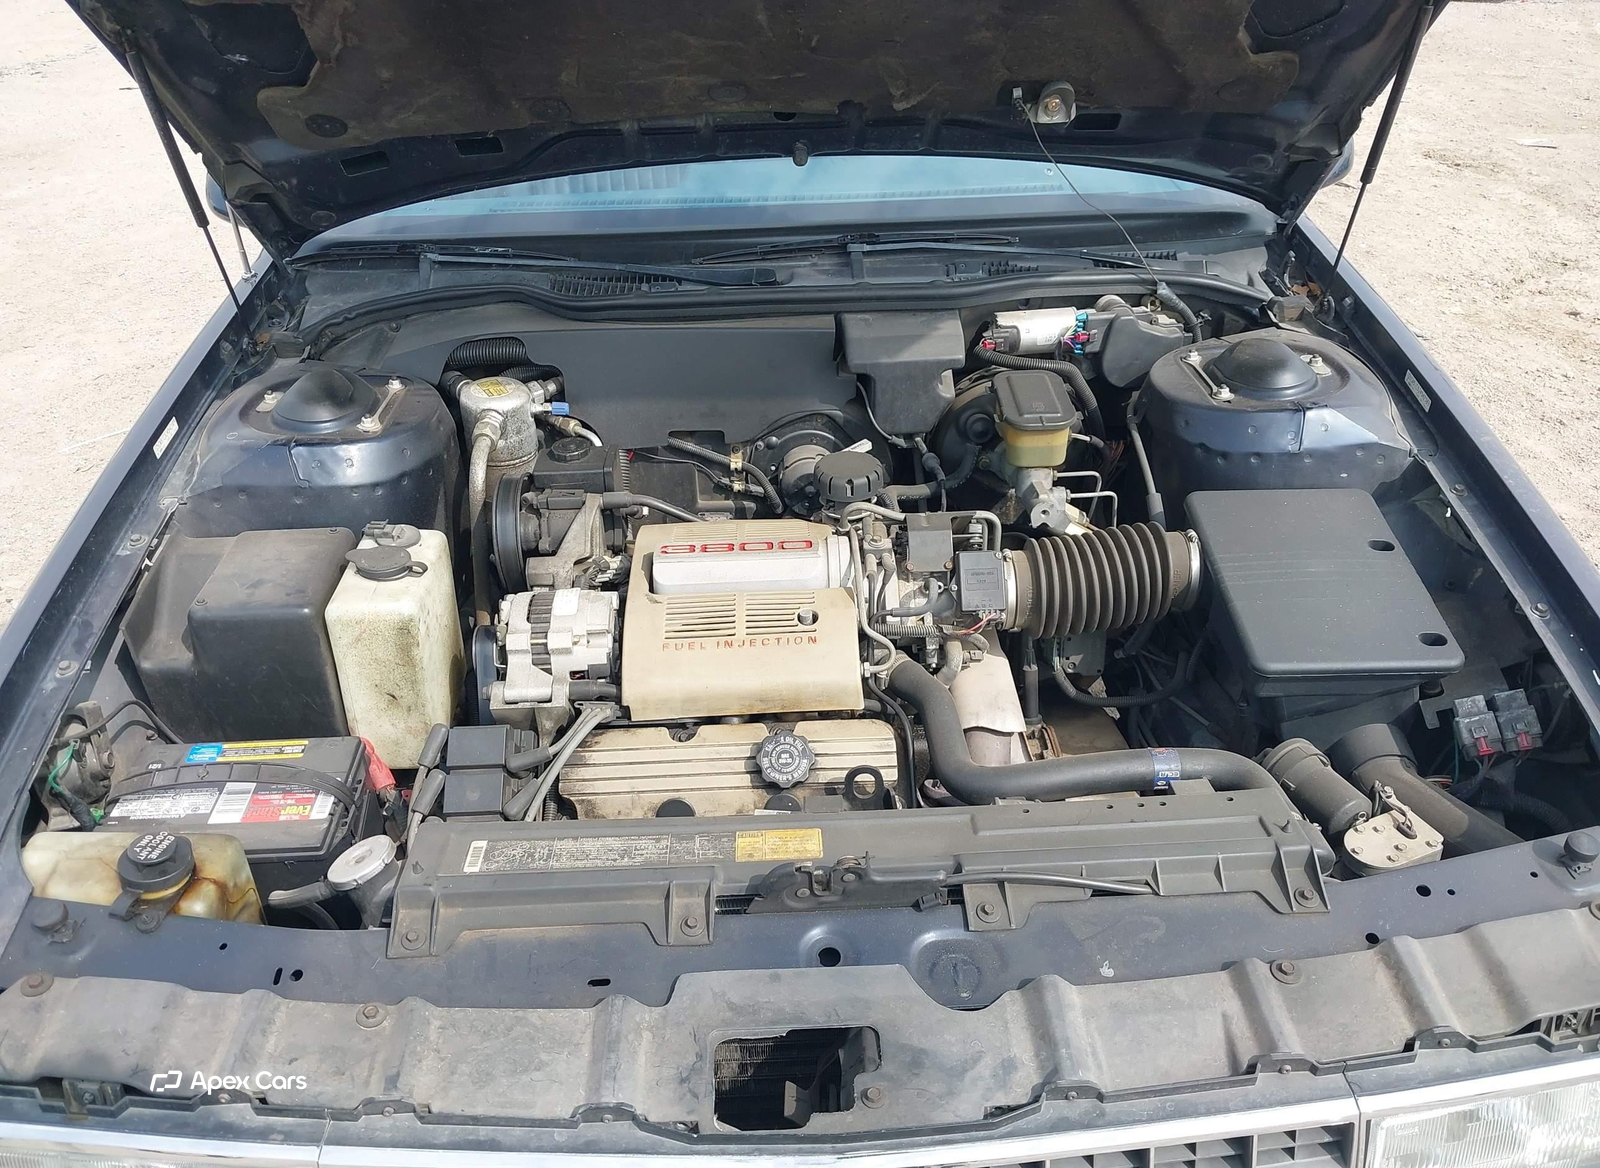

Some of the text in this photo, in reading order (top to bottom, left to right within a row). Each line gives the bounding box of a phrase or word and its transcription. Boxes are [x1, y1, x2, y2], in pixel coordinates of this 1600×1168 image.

[660, 540, 813, 555] 3800
[662, 635, 818, 651] FUEL INJECTION
[133, 835, 154, 853] ONLY
[137, 831, 168, 860] COOLANT
[147, 835, 175, 860] ENGINE
